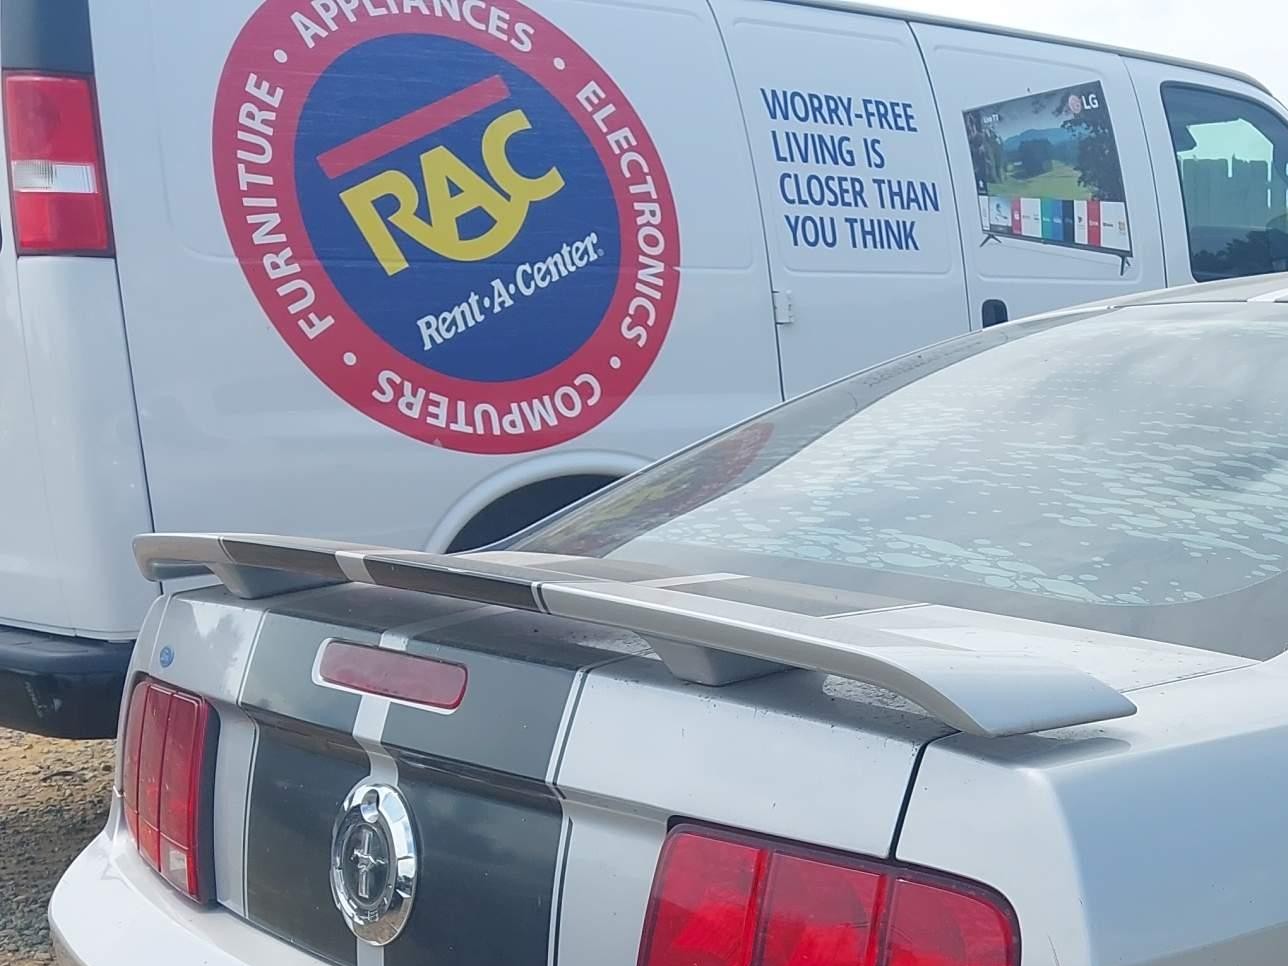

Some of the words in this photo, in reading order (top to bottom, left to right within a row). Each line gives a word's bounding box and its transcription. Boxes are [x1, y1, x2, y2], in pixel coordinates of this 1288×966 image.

[759, 87, 919, 133] WORRY-FREE
[1081, 93, 1099, 110] LG
[770, 130, 856, 167] LIVING
[862, 137, 886, 169] IS
[235, 72, 335, 341] FURNITURE
[338, 108, 566, 277] RAC
[575, 79, 666, 348] ELECTRONICS
[779, 172, 869, 209] CLOSER
[871, 178, 940, 212] THAN
[783, 214, 838, 249] YOU
[844, 217, 920, 251] THINK
[371, 369, 602, 436] COMPUTERS
